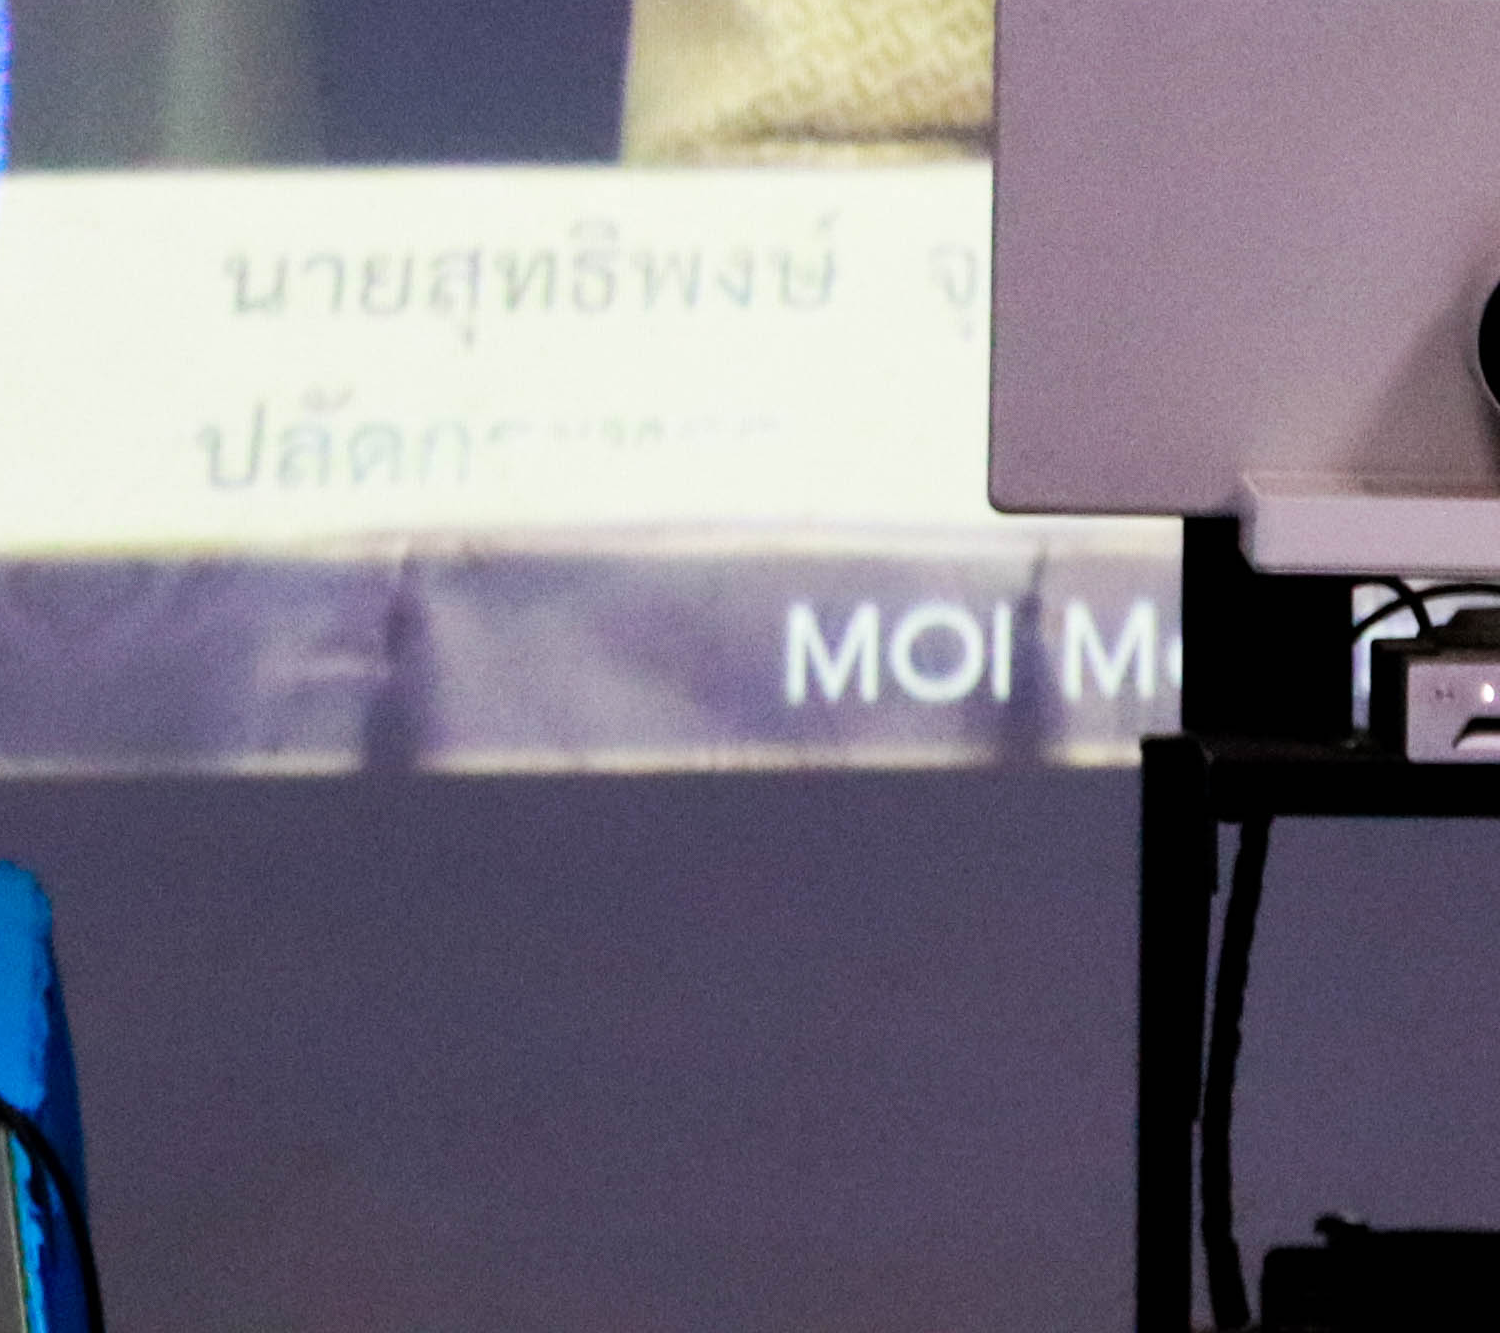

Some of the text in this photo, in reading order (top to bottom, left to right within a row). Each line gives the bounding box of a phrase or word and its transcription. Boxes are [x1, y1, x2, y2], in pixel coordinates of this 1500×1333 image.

[223, 211, 841, 351] นายสุทธิพงษ์
[784, 597, 1183, 706] MOI M
